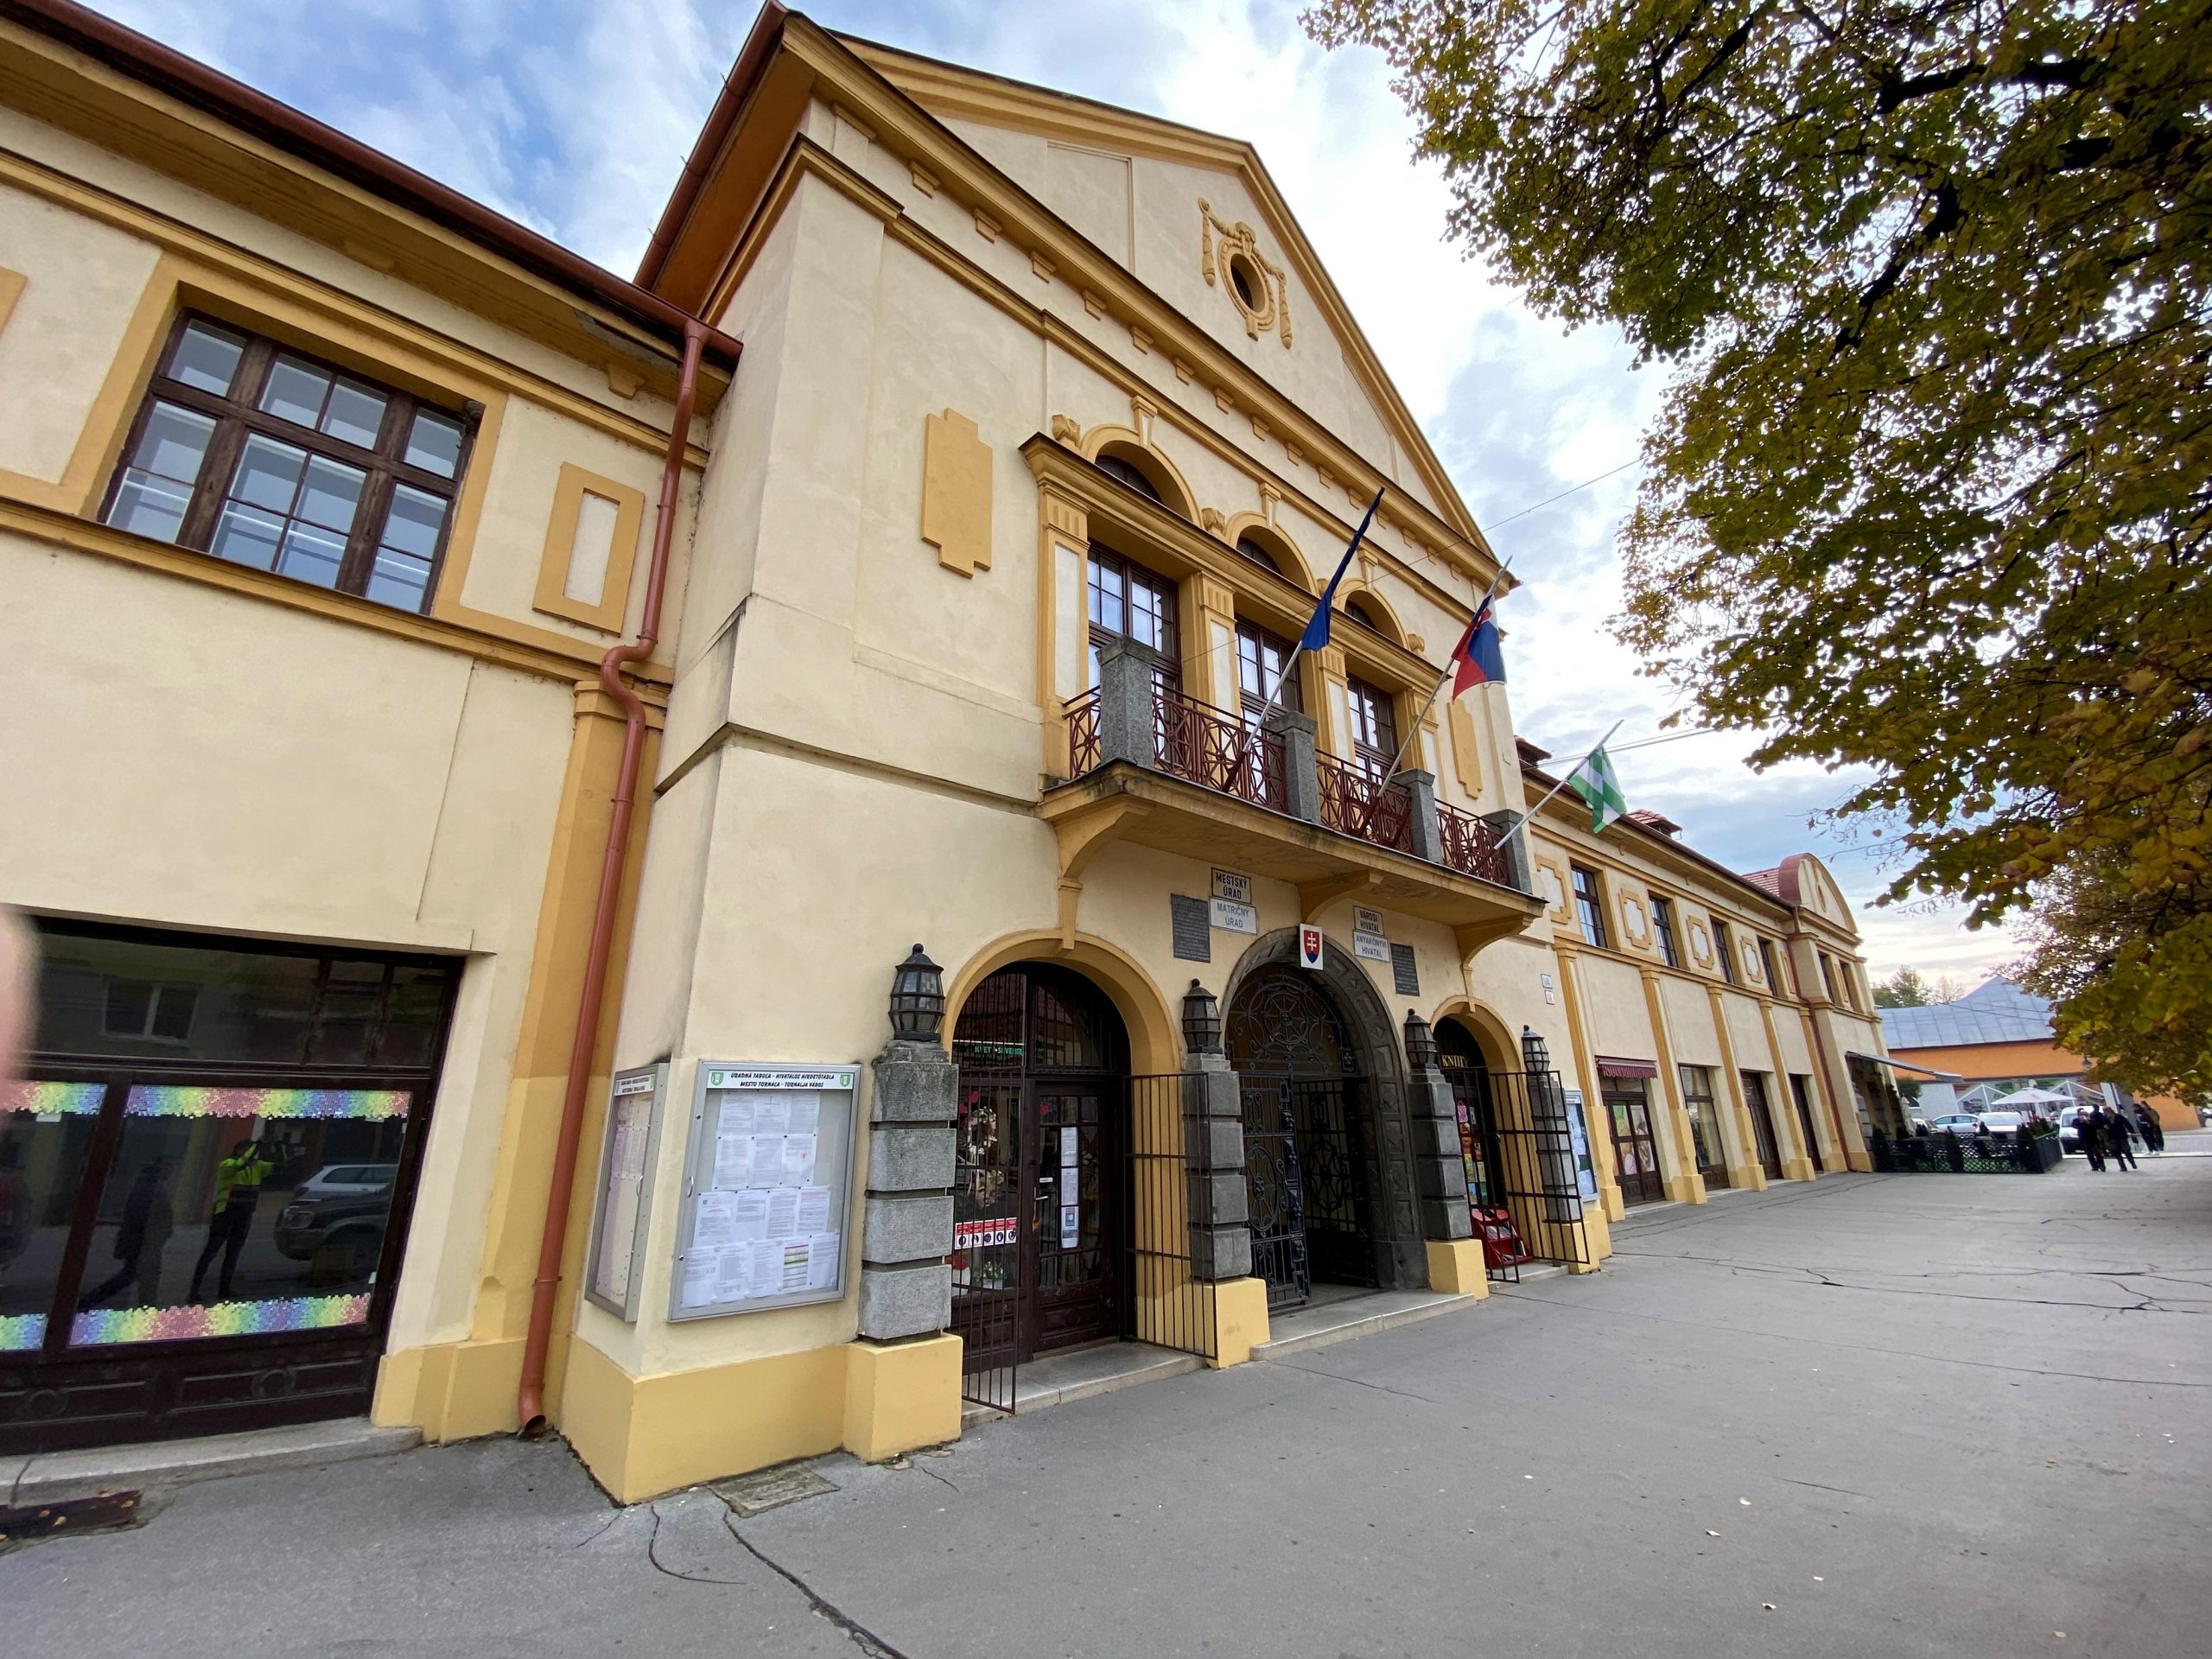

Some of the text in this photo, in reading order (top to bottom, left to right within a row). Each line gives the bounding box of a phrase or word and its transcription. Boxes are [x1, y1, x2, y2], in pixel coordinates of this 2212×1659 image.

[1216, 872, 1248, 889] MESTSKÝ
[1223, 885, 1242, 899] ÚRAD
[1217, 902, 1249, 918] MATRIČNÝ
[1359, 909, 1378, 922] VÁROSI
[1224, 915, 1243, 928] ÚRAD
[1360, 920, 1380, 933] HIVATAL
[1361, 945, 1383, 958] HIVATAL
